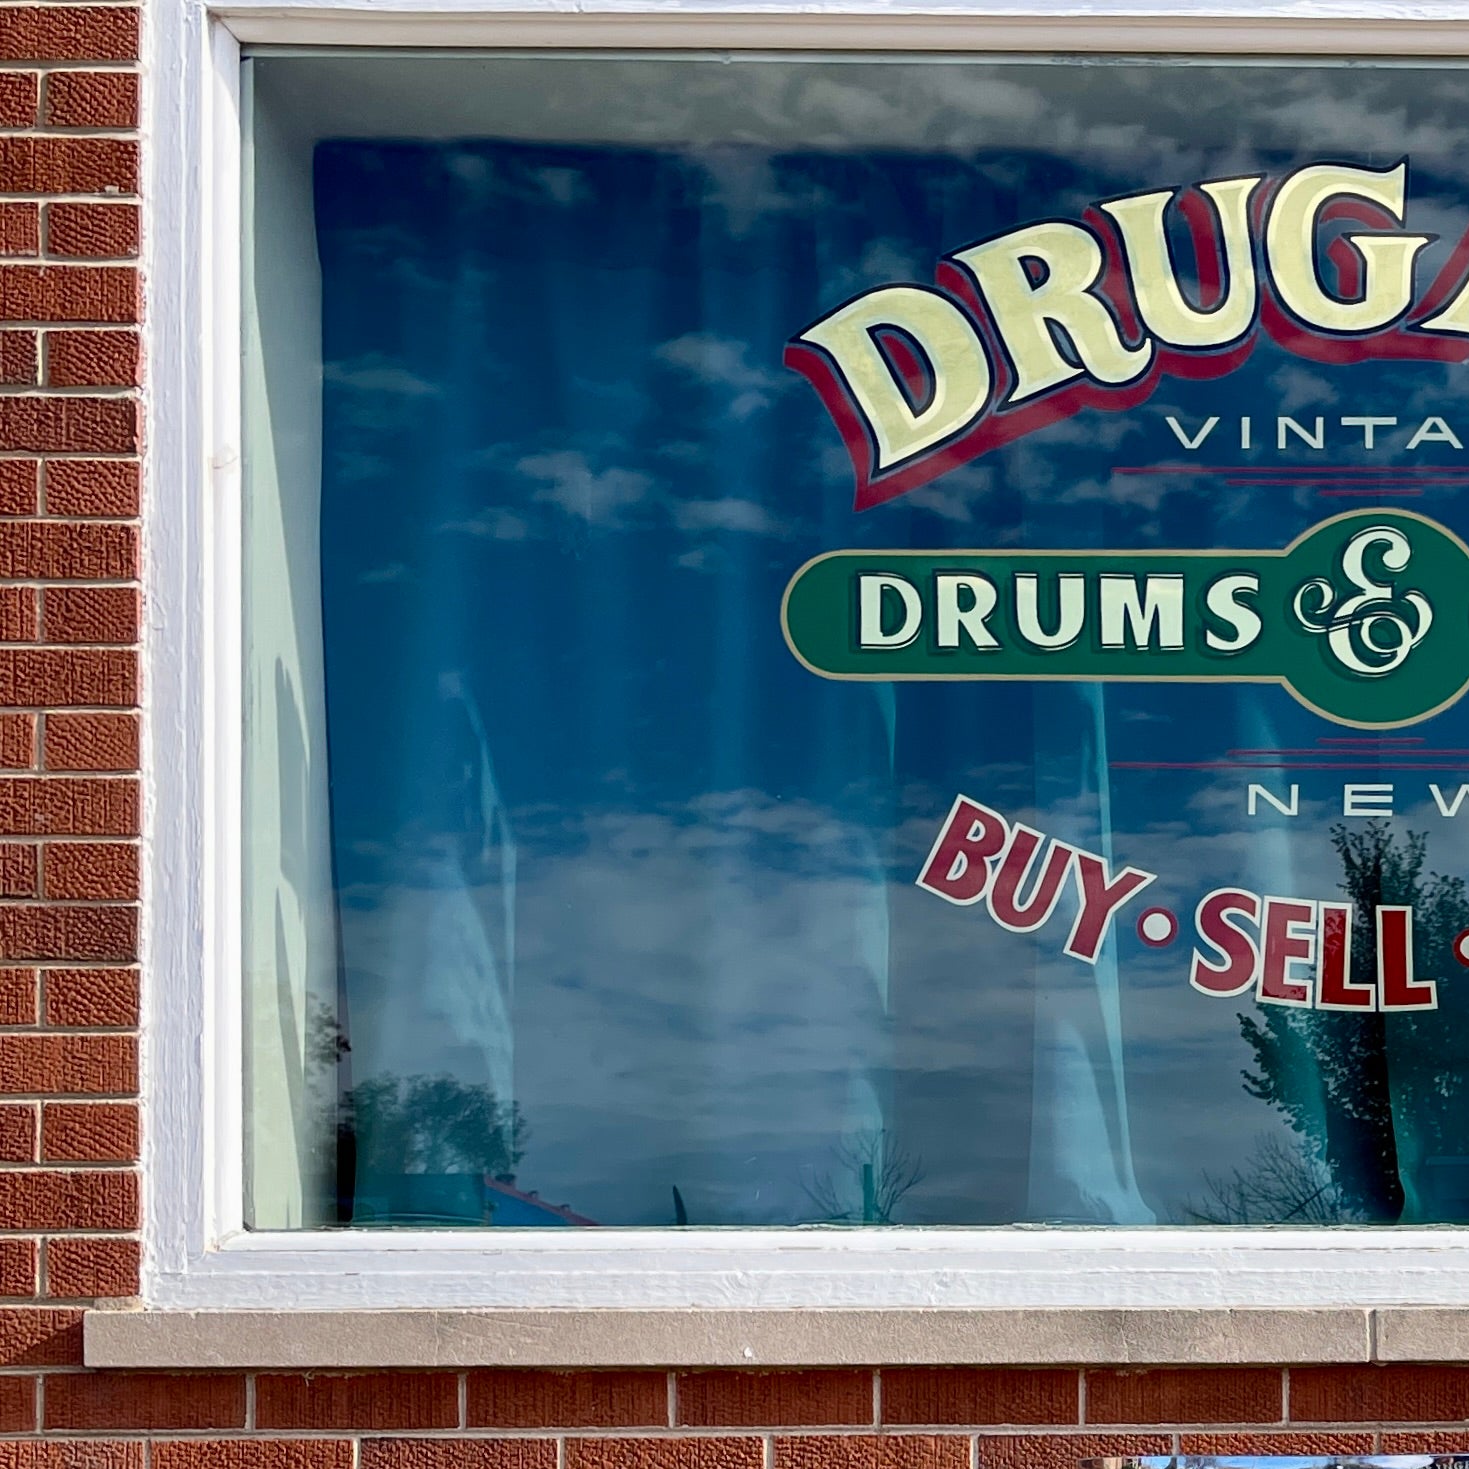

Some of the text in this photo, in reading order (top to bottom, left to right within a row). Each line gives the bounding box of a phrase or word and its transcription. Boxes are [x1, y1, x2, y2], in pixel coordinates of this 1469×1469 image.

[854, 572, 1263, 654] DRUMS
[1293, 527, 1434, 677] &
[915, 793, 1158, 964] BUY
[1189, 888, 1438, 1012] SELL
